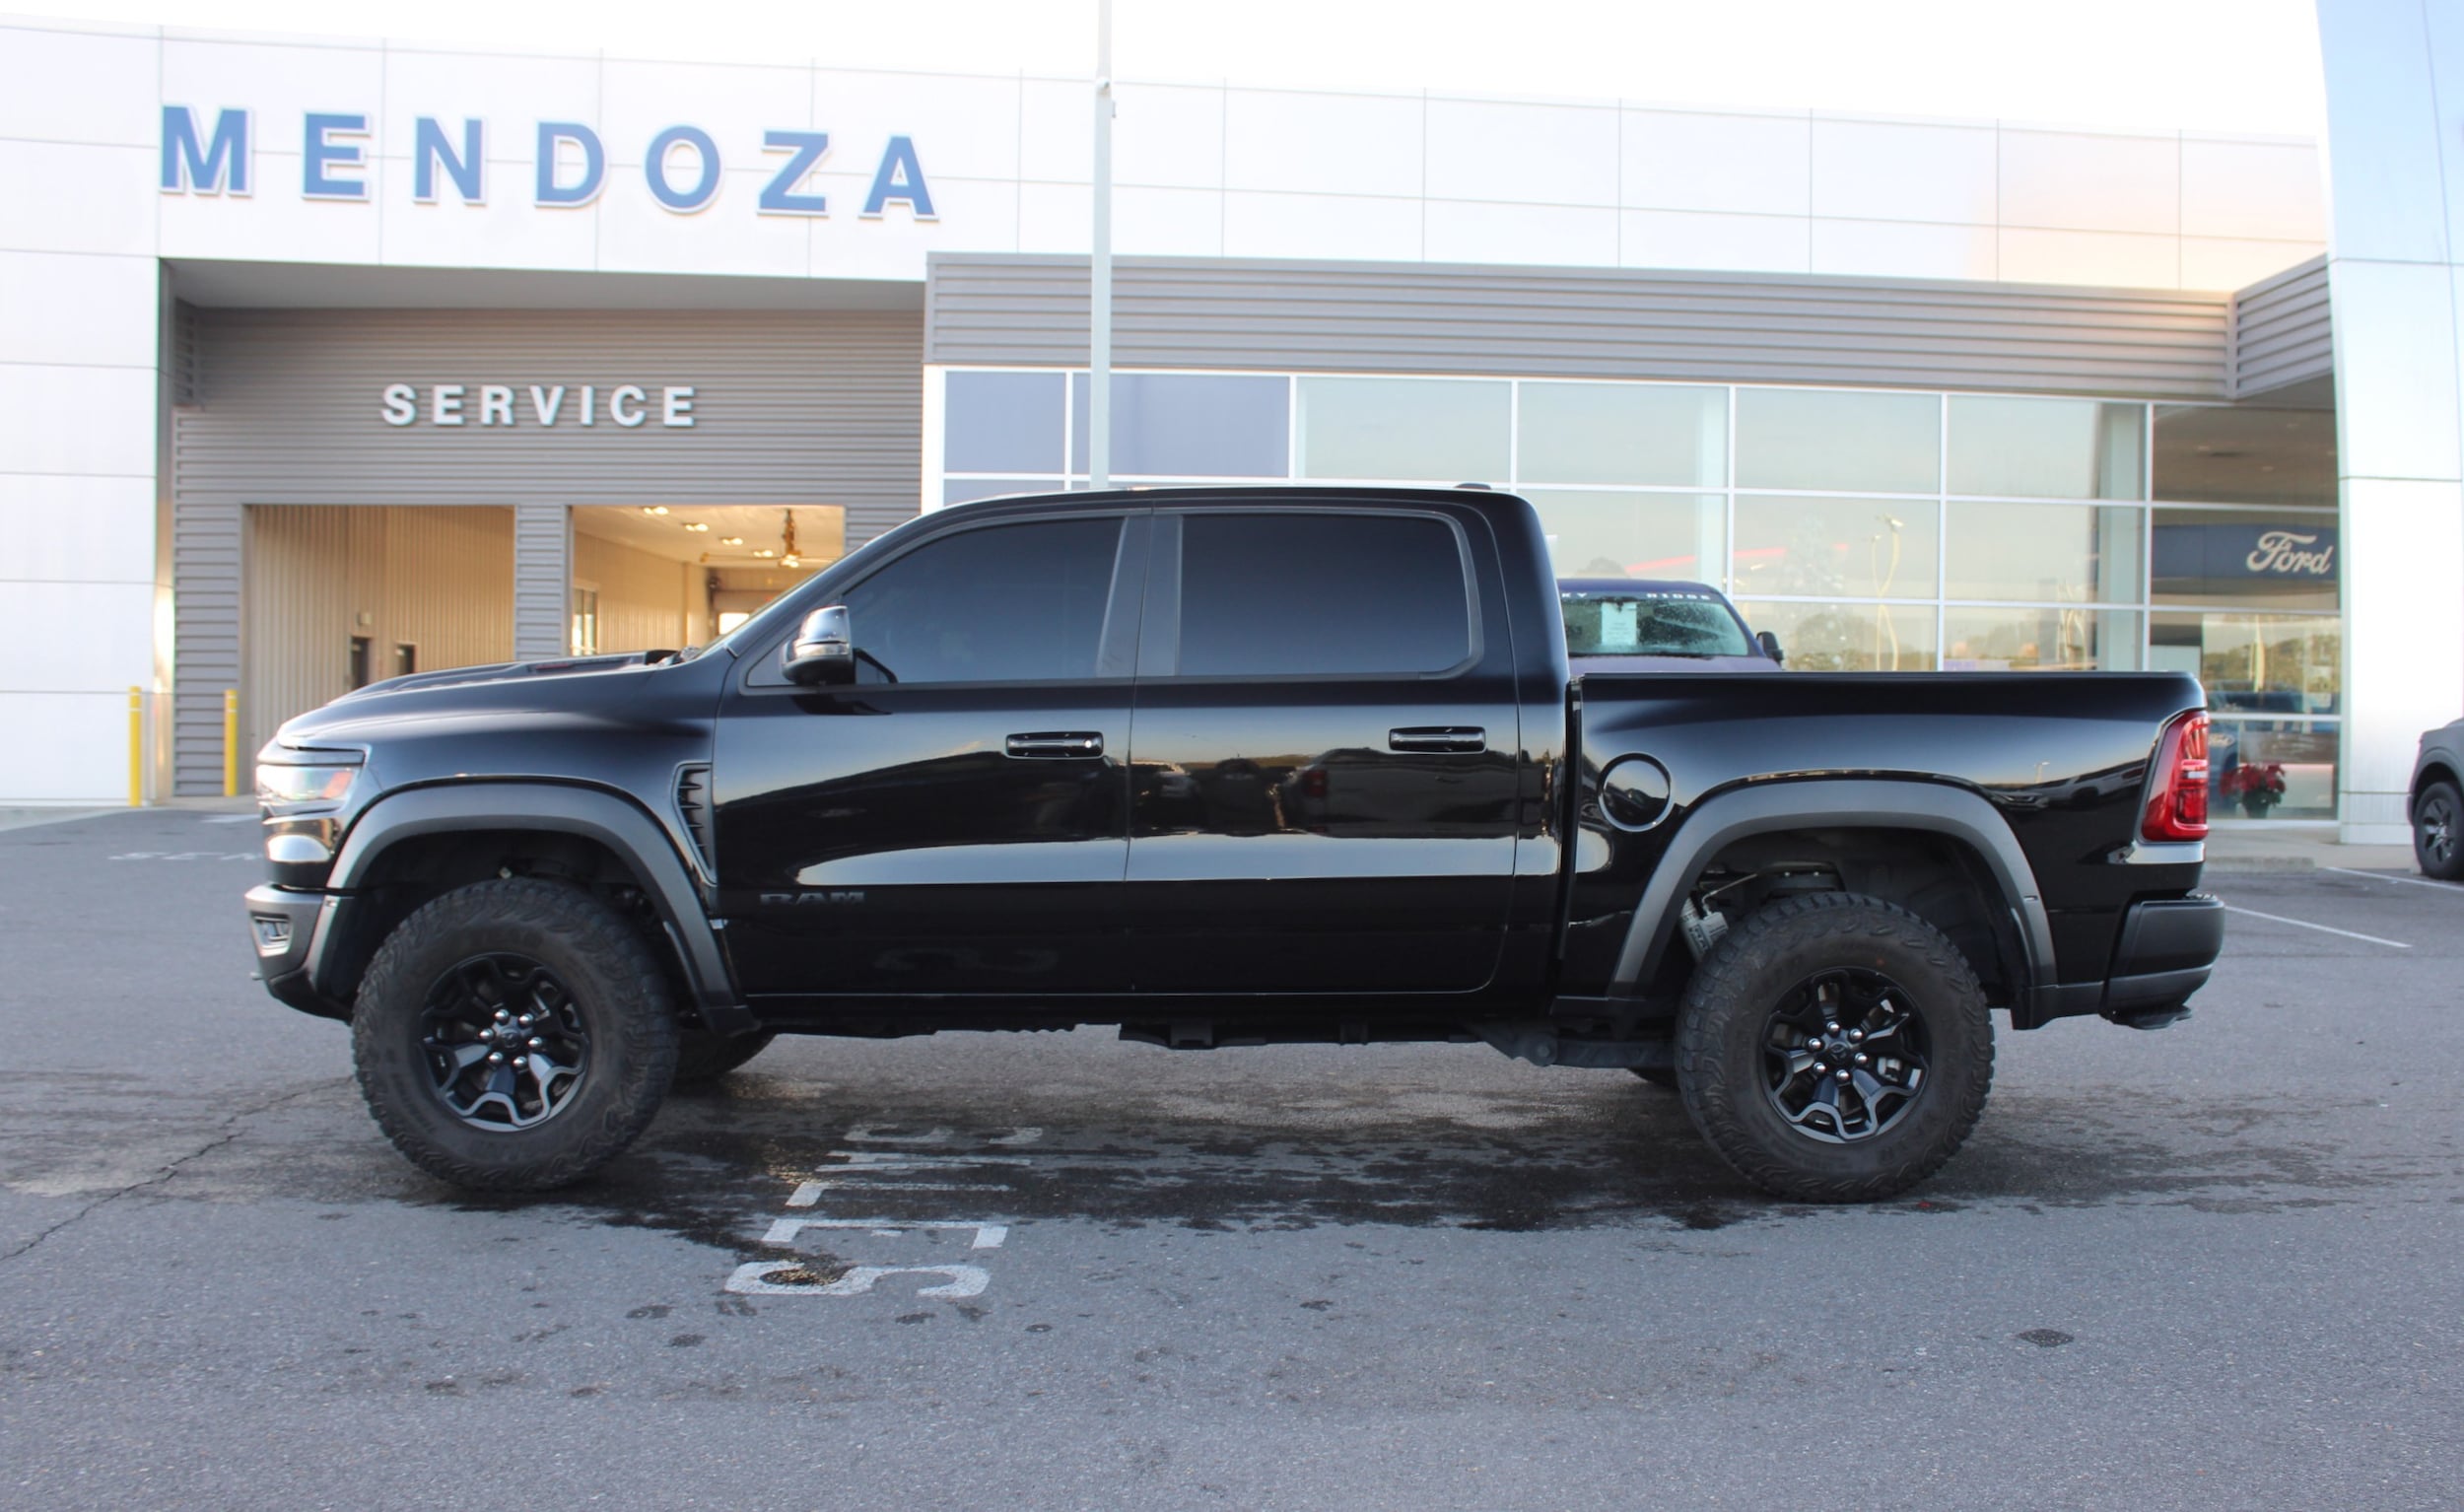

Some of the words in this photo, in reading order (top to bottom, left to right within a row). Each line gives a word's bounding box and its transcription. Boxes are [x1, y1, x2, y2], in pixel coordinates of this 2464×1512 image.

[160, 105, 939, 221] MENDOZA
[381, 383, 697, 428] SERVICE
[2247, 530, 2333, 575] Ford
[759, 891, 865, 906] RAM
